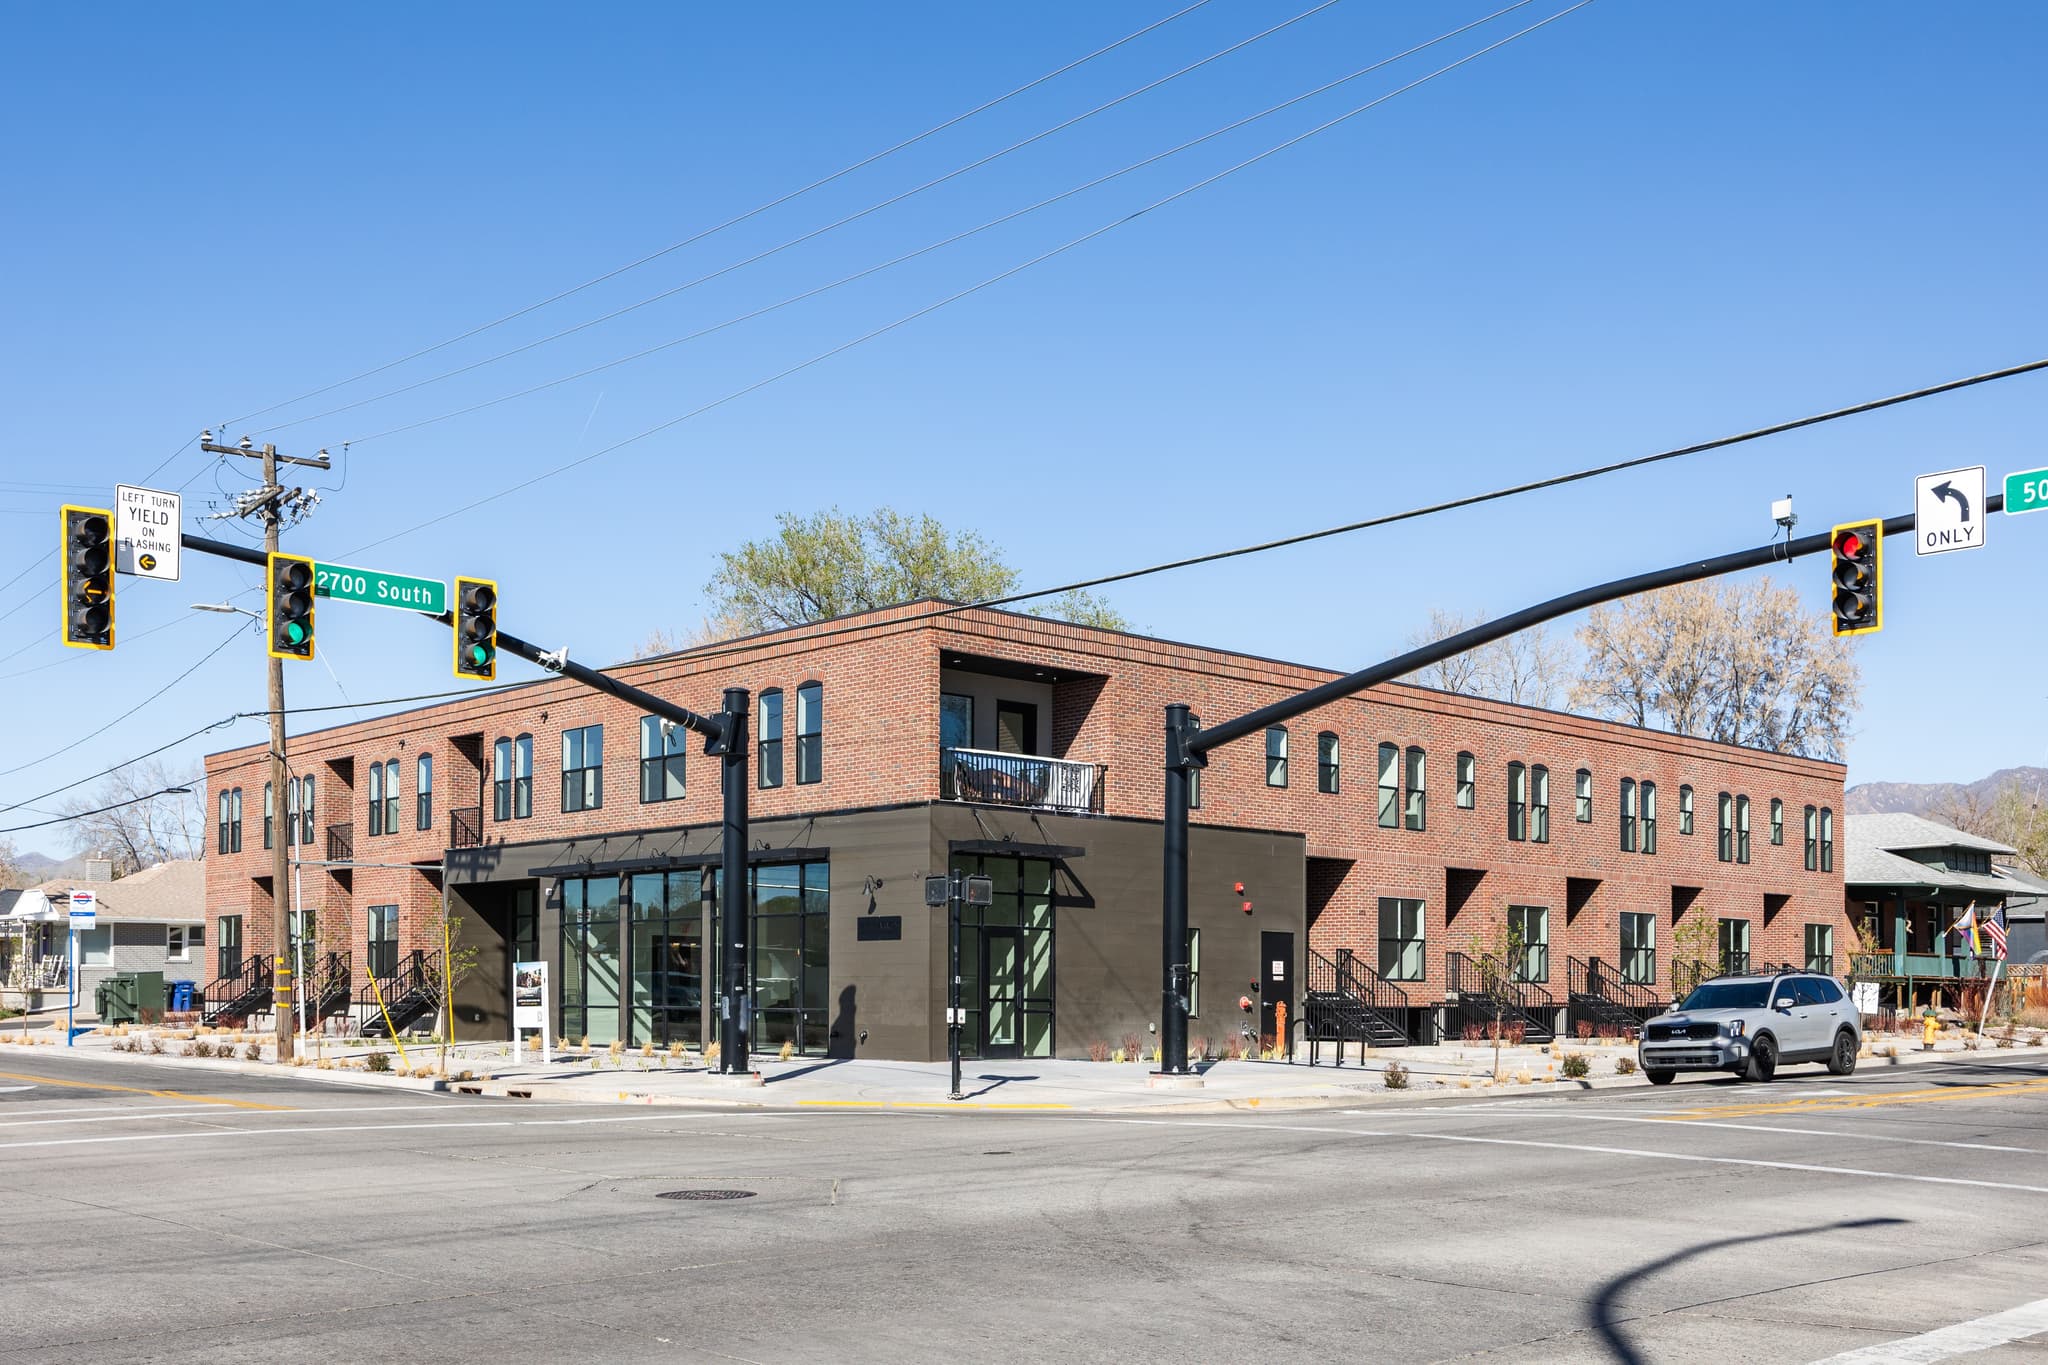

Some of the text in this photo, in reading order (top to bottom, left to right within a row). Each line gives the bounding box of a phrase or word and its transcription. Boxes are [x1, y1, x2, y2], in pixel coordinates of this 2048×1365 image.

[122, 491, 176, 509] LEFT TURN
[129, 506, 169, 526] YIELD
[142, 527, 155, 537] ON
[1926, 526, 1974, 547] ONLY
[124, 537, 171, 553] FLASHING
[317, 571, 432, 605] 2700 South
